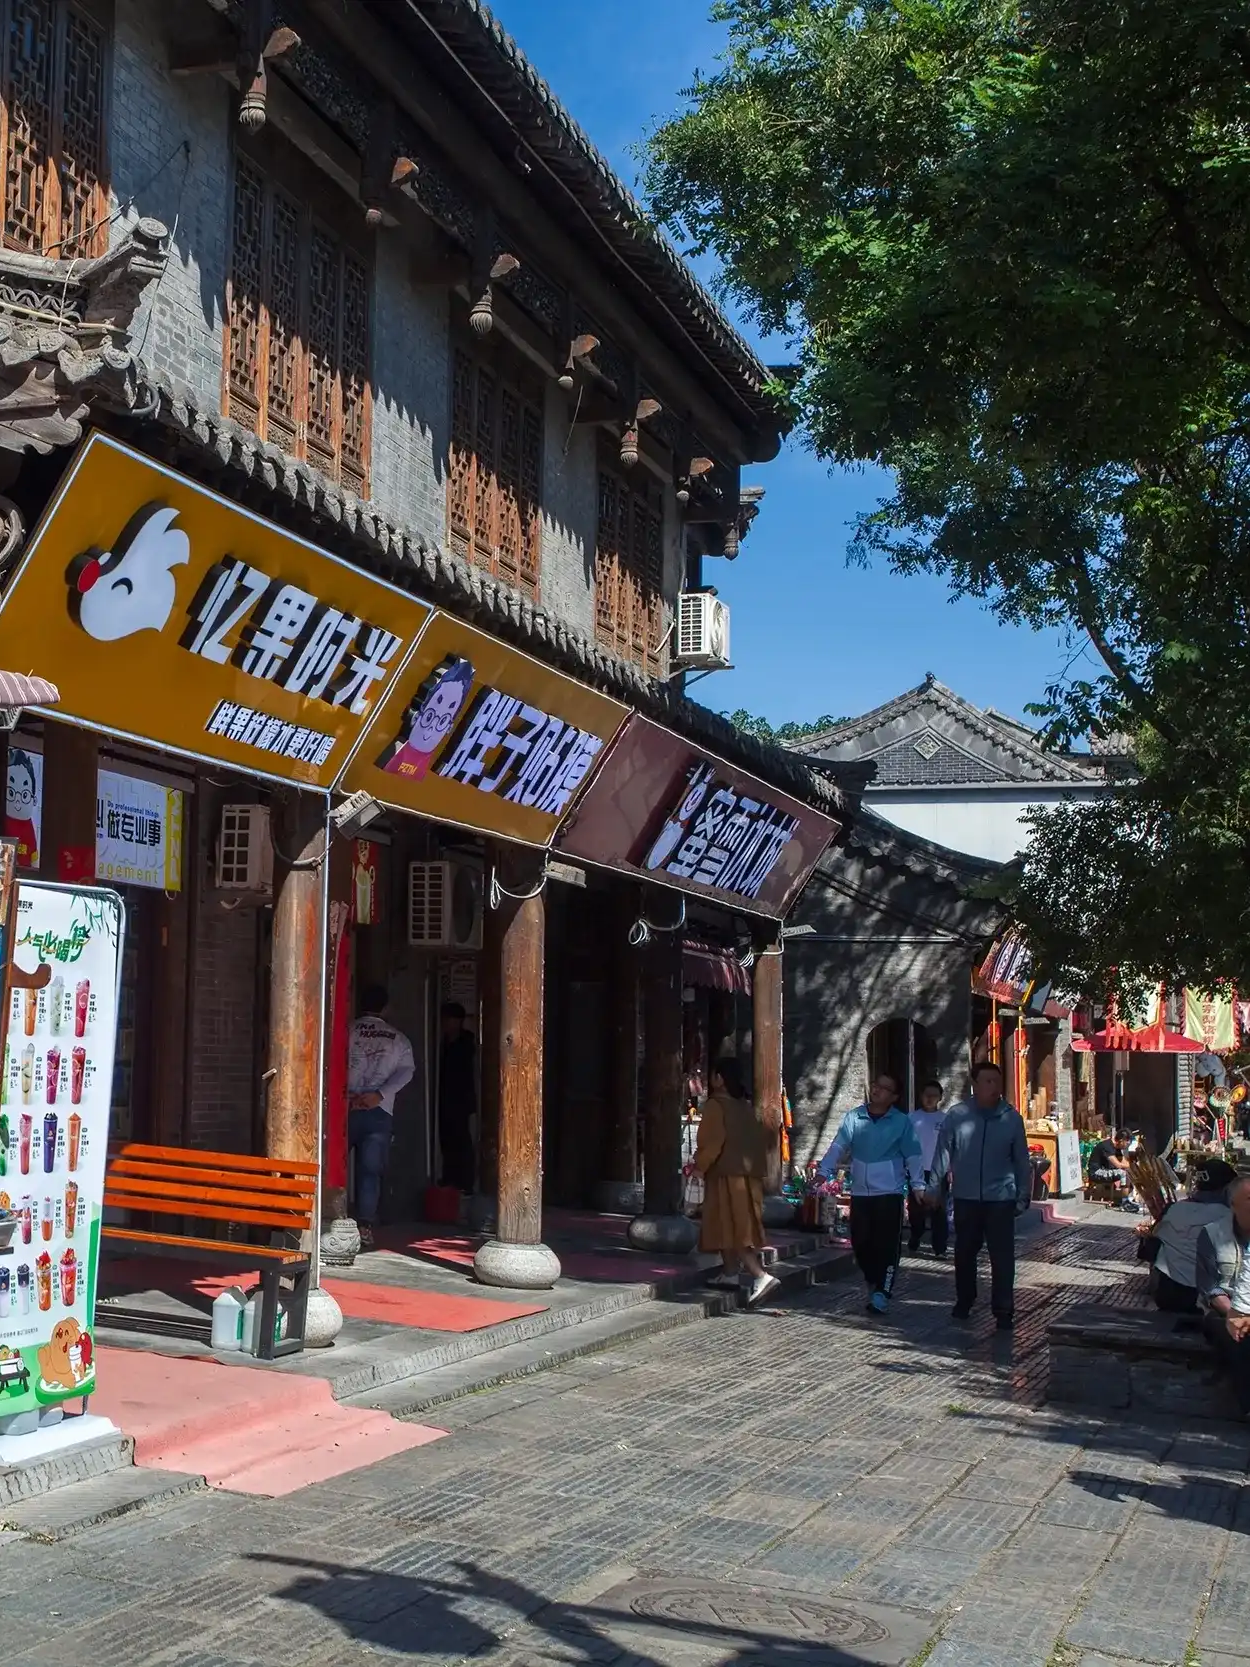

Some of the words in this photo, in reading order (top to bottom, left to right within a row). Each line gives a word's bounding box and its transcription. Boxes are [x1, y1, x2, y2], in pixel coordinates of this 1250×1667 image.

[190, 560, 404, 716] 忆果时光
[208, 702, 337, 766] 鲜果柠檬水更好喝
[439, 688, 604, 816] 胖子贴膜
[107, 808, 161, 846] 做专业事
[666, 786, 801, 899] 蜜雪冰城
